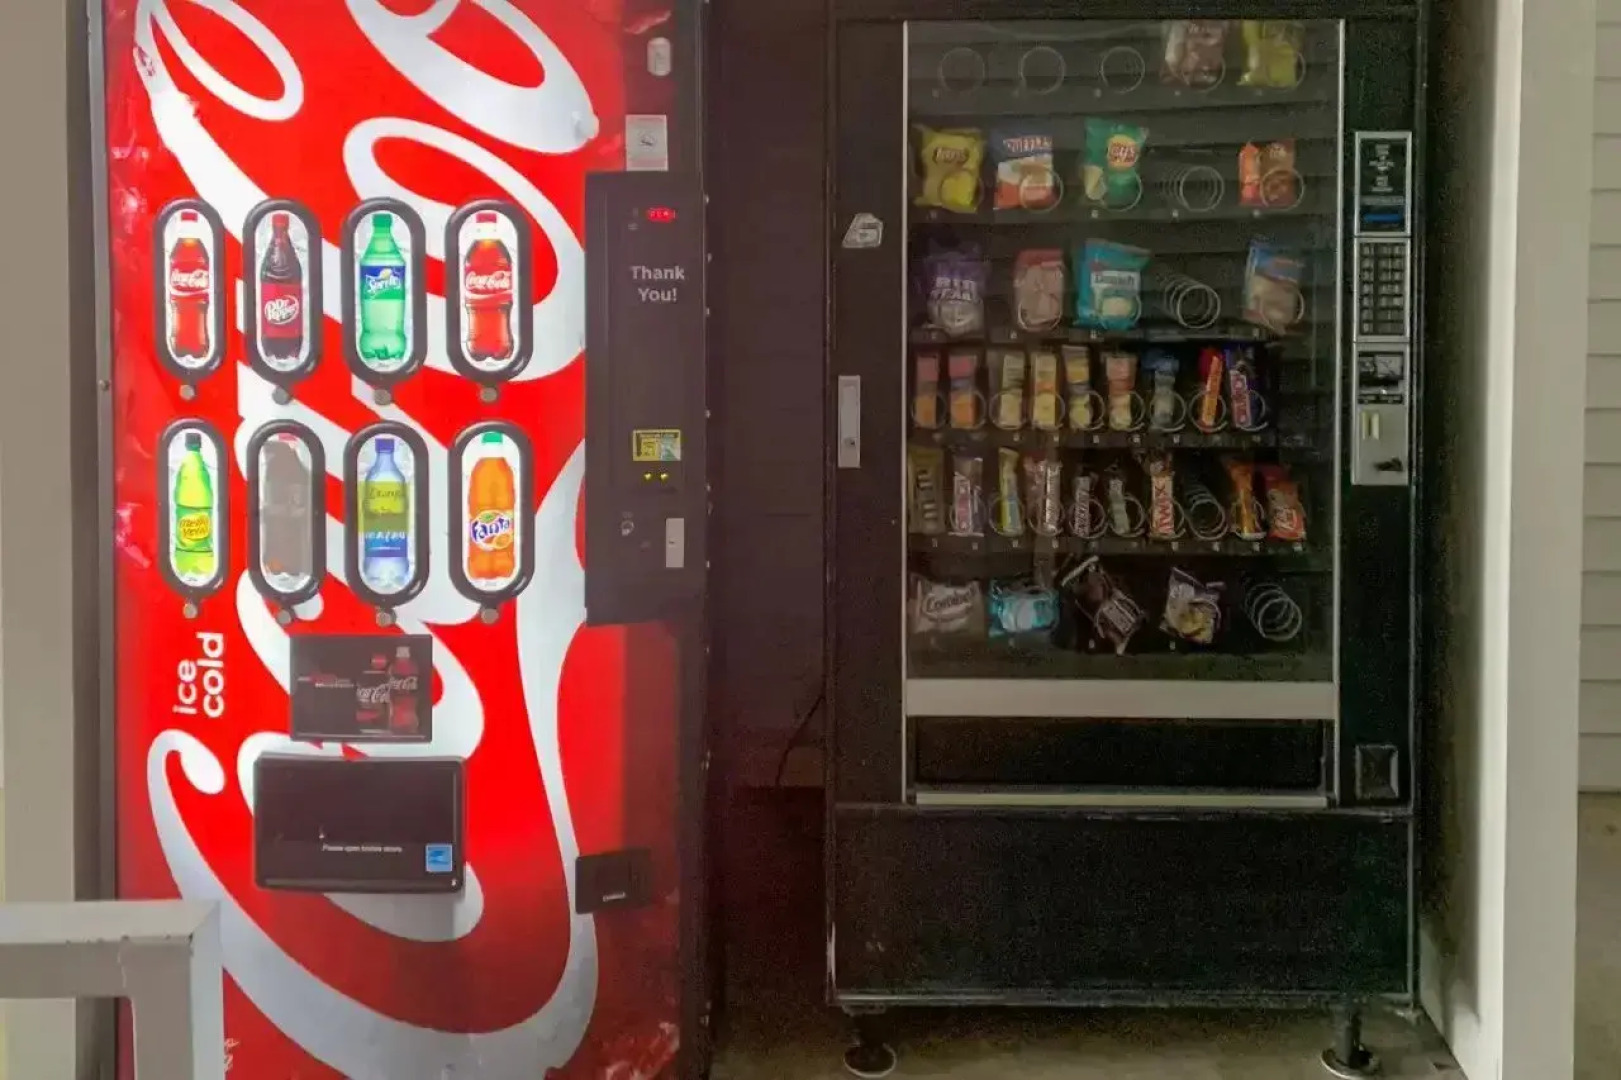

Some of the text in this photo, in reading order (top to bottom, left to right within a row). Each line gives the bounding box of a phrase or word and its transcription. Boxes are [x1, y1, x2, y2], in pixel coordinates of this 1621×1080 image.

[630, 265, 686, 281] Thank
[637, 288, 678, 302] You!
[471, 516, 513, 542] Fanta
[197, 632, 225, 718] cold
